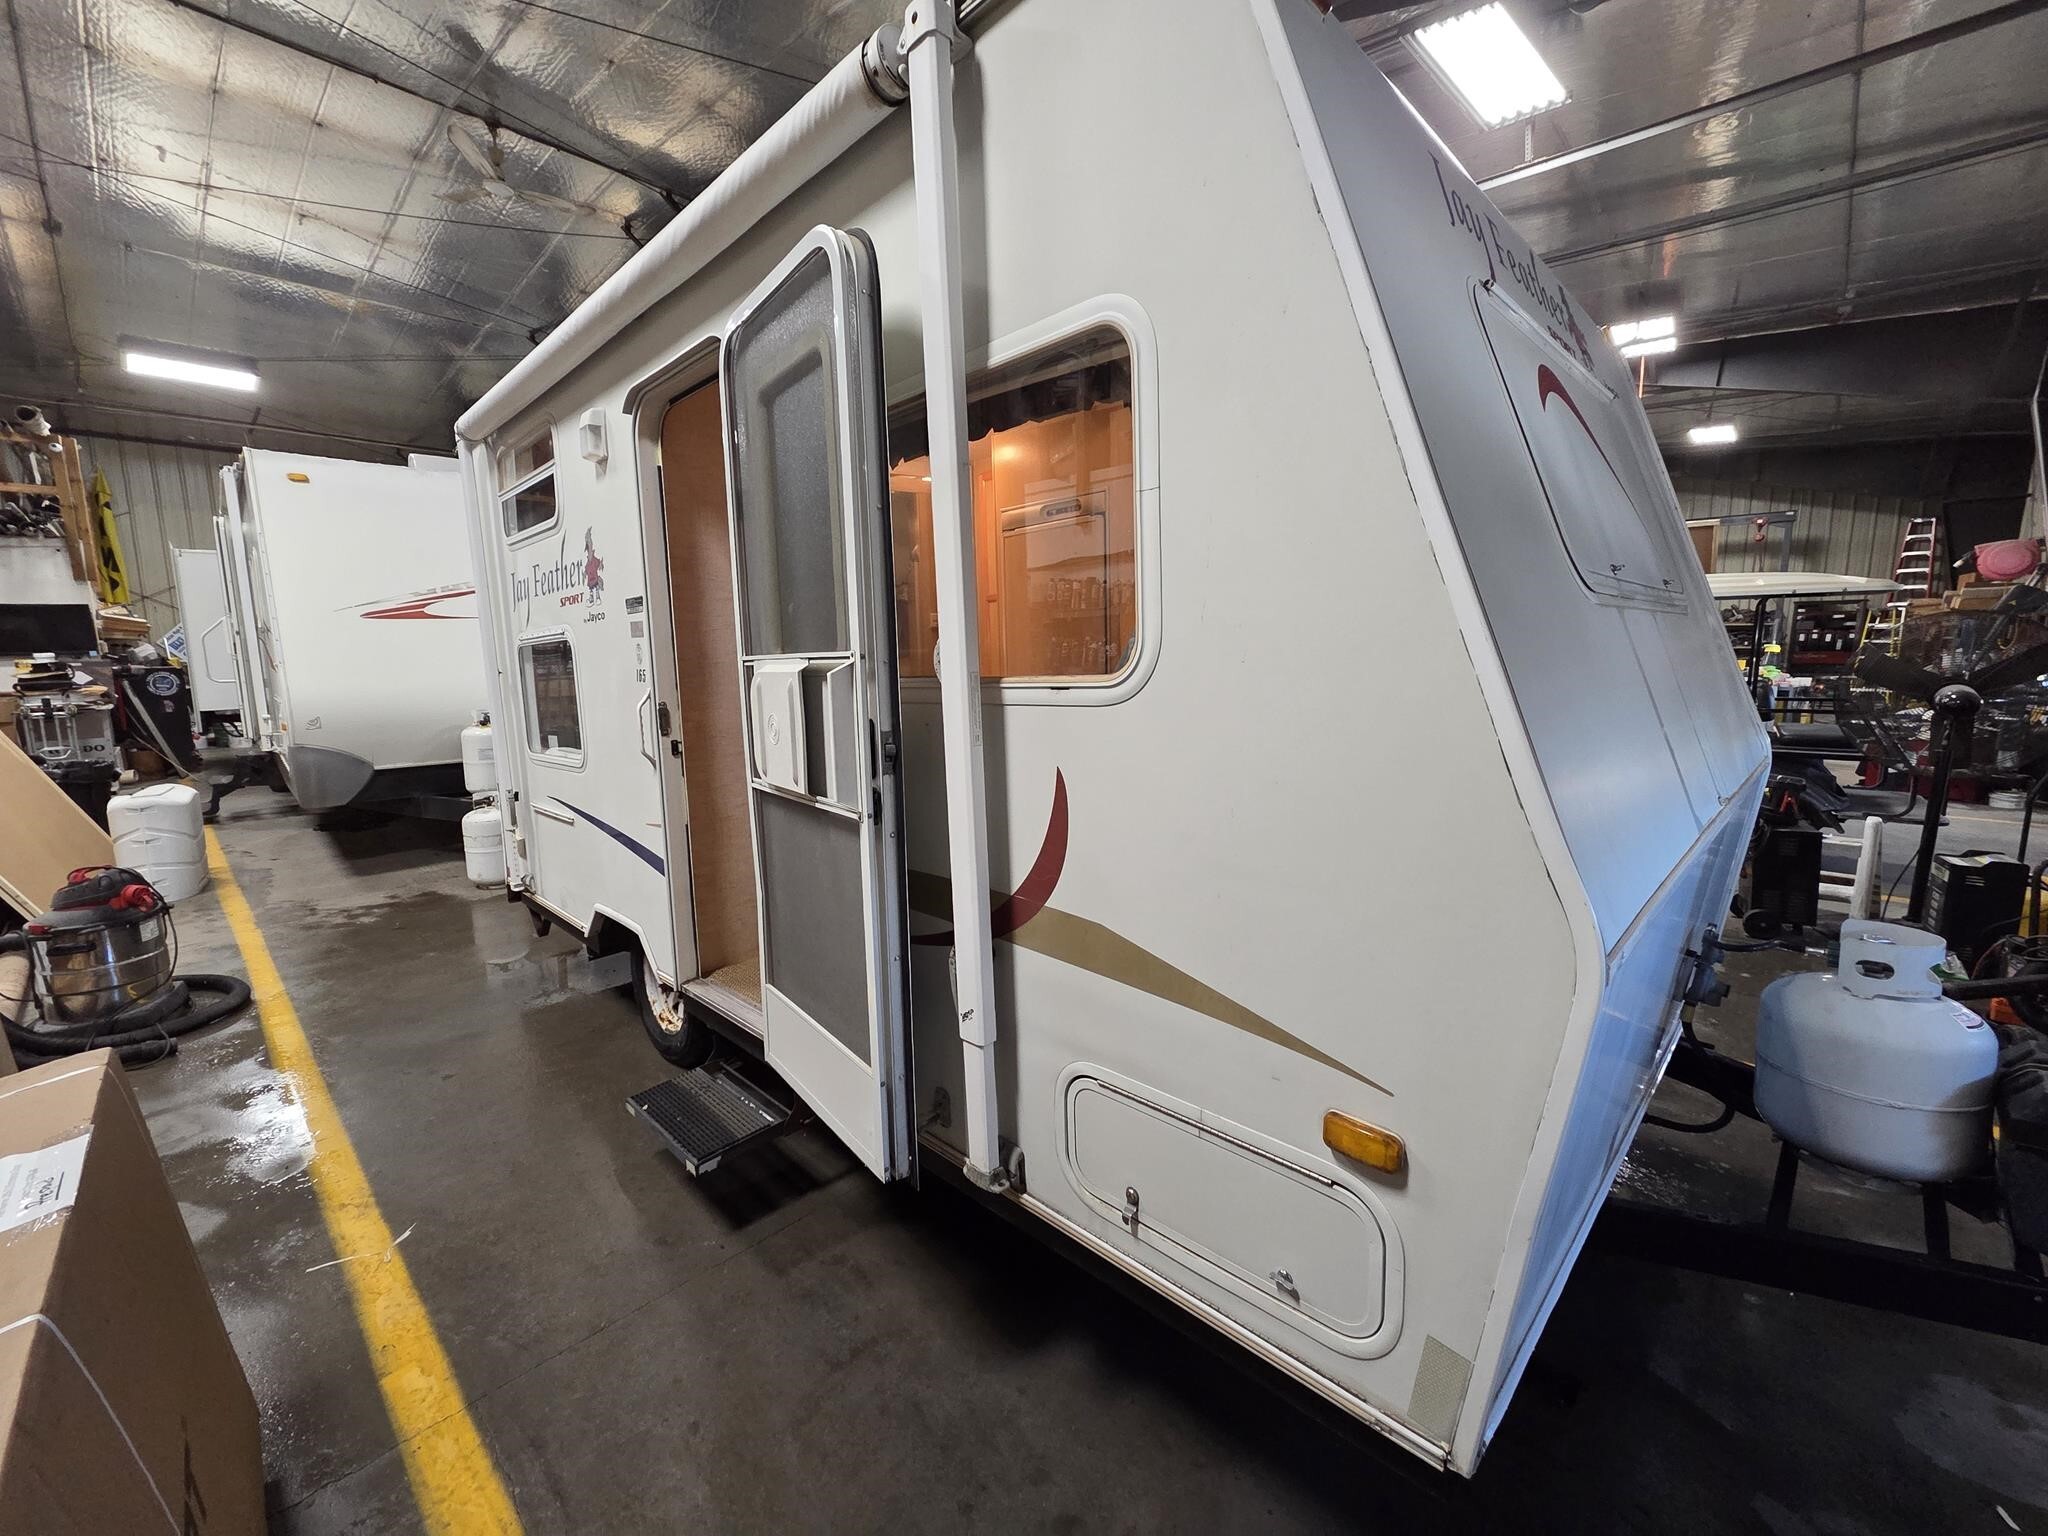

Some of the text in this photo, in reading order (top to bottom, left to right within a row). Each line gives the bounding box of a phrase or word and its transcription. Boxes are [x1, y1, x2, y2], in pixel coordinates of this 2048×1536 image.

[1428, 150, 1567, 331] Jay Feather
[511, 529, 585, 630] Jay Feather
[559, 592, 584, 607] SPORT
[587, 611, 605, 623] Jayco
[636, 668, 646, 682] 165
